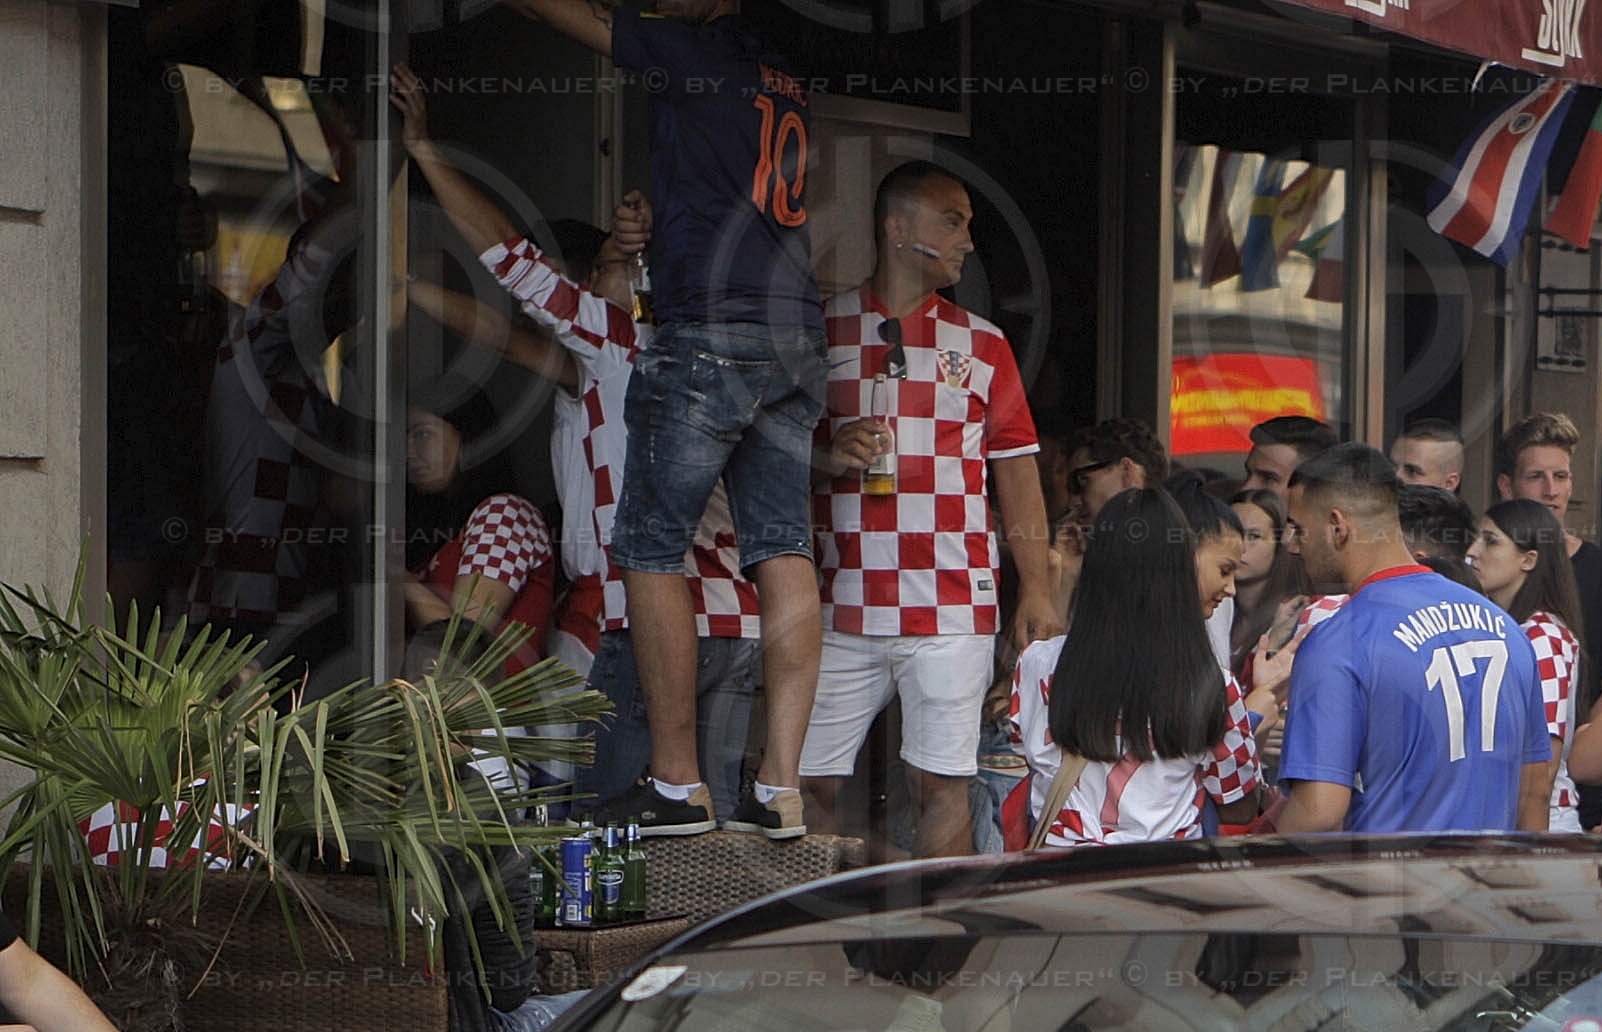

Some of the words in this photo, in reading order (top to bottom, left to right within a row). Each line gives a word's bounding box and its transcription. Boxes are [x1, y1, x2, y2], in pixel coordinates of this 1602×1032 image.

[752, 94, 807, 227] 10
[1393, 601, 1507, 653] MANDŽUKIĆ
[1425, 639, 1509, 763] 17
